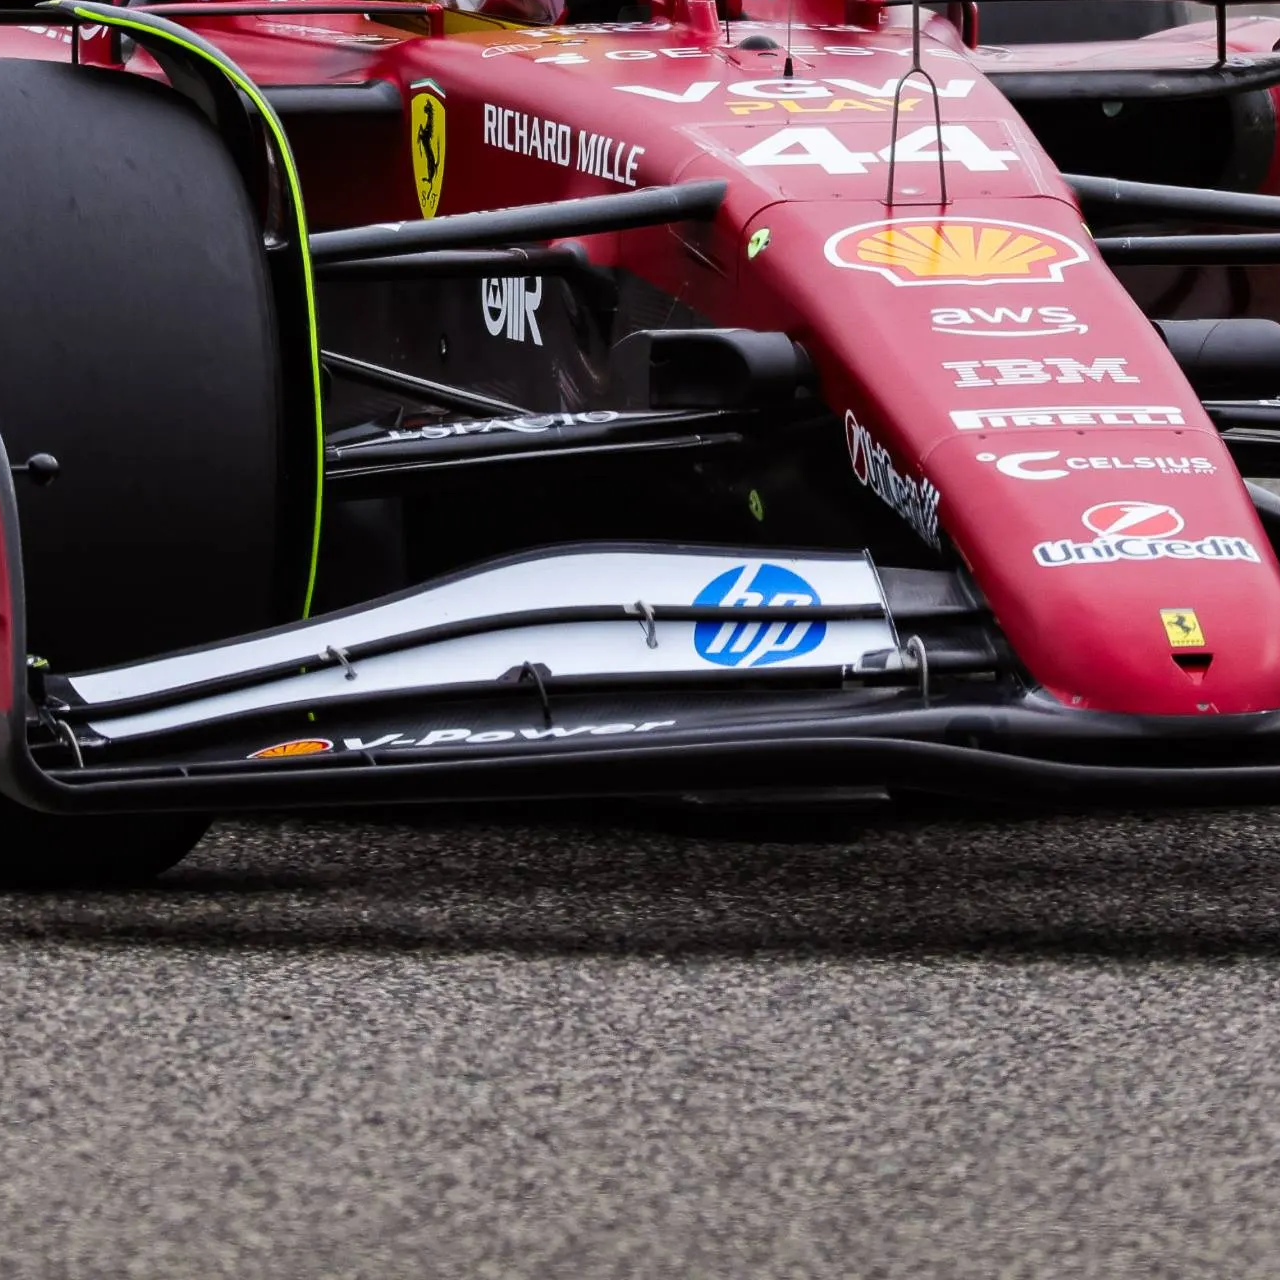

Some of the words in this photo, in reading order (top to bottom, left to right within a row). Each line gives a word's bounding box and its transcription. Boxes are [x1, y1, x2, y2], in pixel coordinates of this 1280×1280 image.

[605, 45, 972, 61] GEESYS
[613, 76, 977, 103] VGW
[724, 97, 923, 115] PLAY
[483, 102, 571, 167] RICHARD
[575, 129, 646, 187] MILLE
[736, 124, 1020, 175] 44
[930, 305, 1077, 325] aws
[941, 357, 1141, 388] IBM
[948, 405, 1186, 430] PIRELLI
[1035, 537, 1257, 565] UniCredit
[704, 563, 813, 668] hp
[343, 719, 678, 751] V-Power
